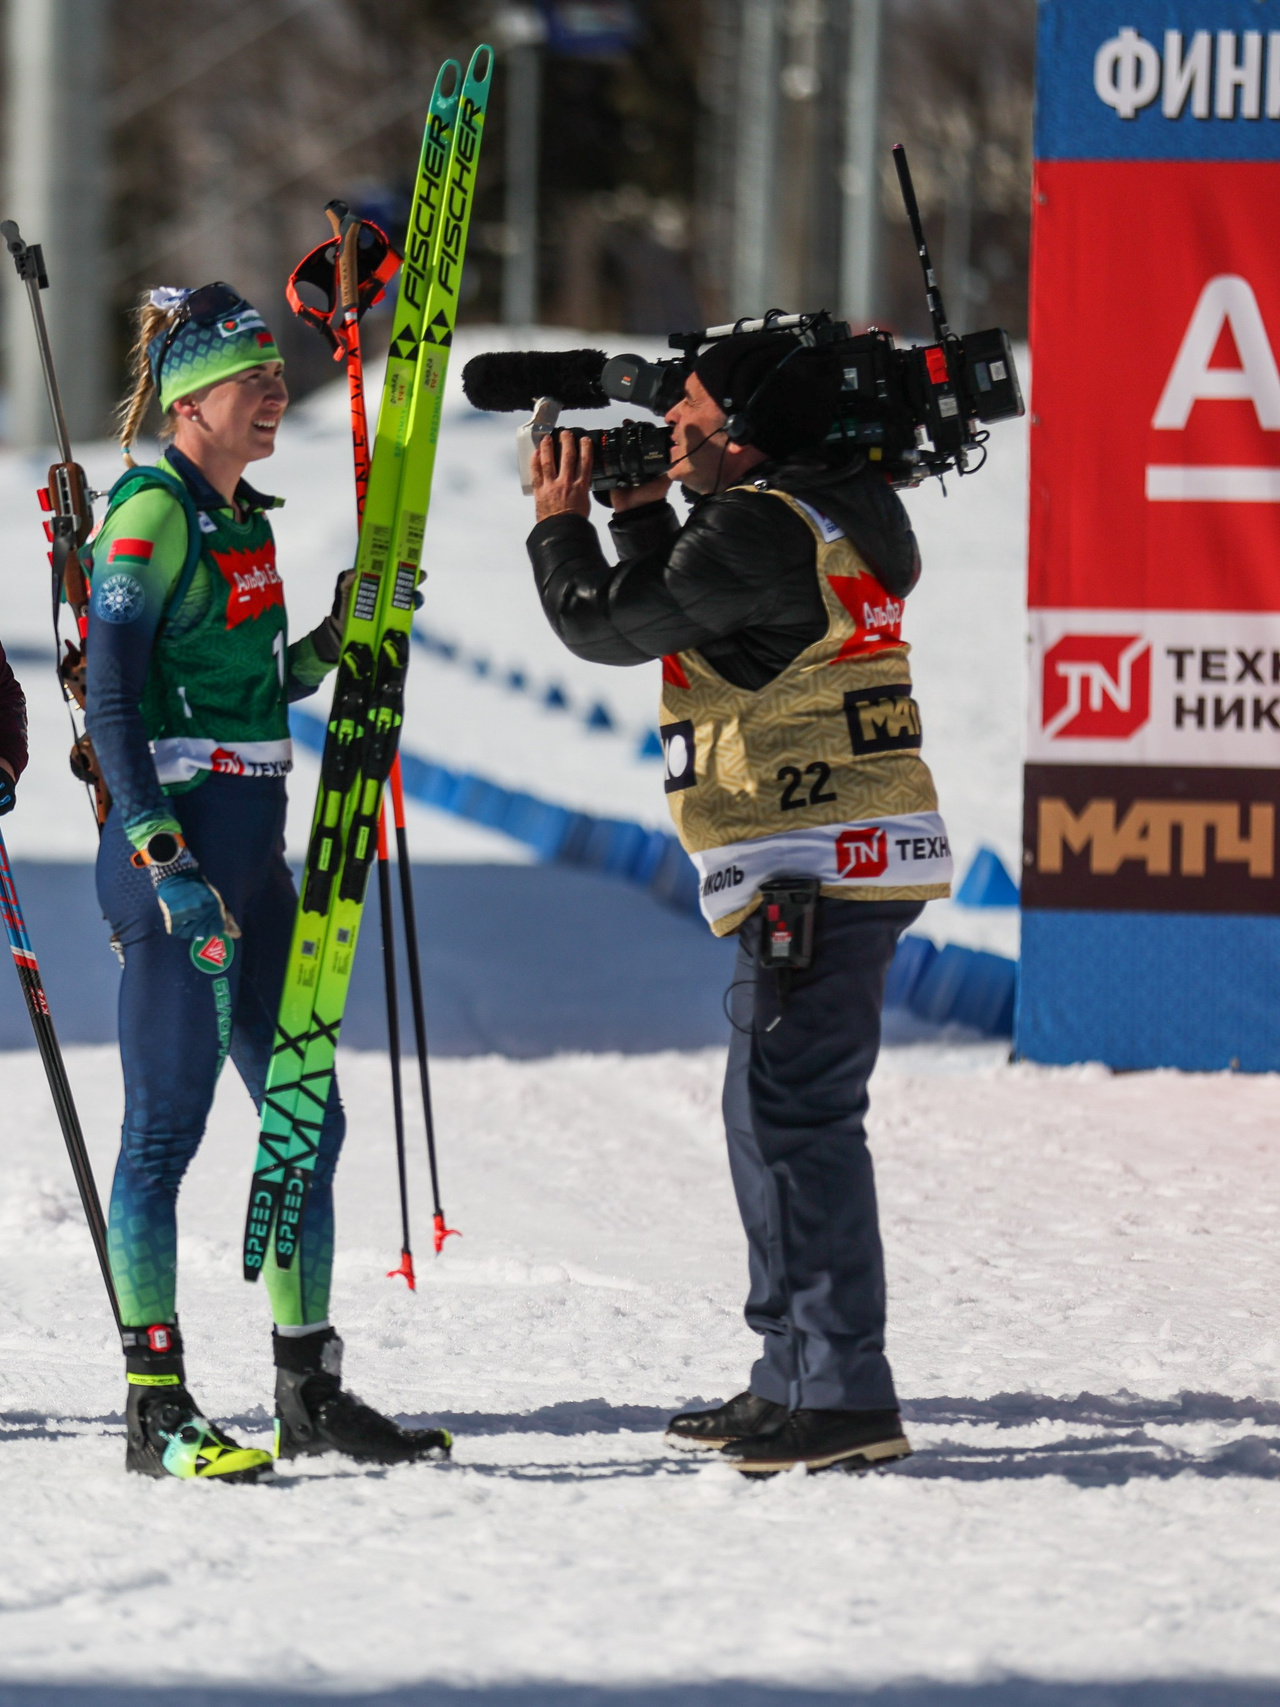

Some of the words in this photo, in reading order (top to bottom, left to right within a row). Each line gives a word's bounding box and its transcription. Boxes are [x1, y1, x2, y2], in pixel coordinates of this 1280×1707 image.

[404, 114, 450, 310] FISCHER
[438, 97, 482, 296] FISCHER
[1167, 649, 1280, 685] ТЕХ
[777, 761, 836, 811] 22
[1038, 797, 1275, 878] МАТЧ
[245, 1190, 272, 1269] SPEED
[277, 1178, 304, 1255] SPEED
